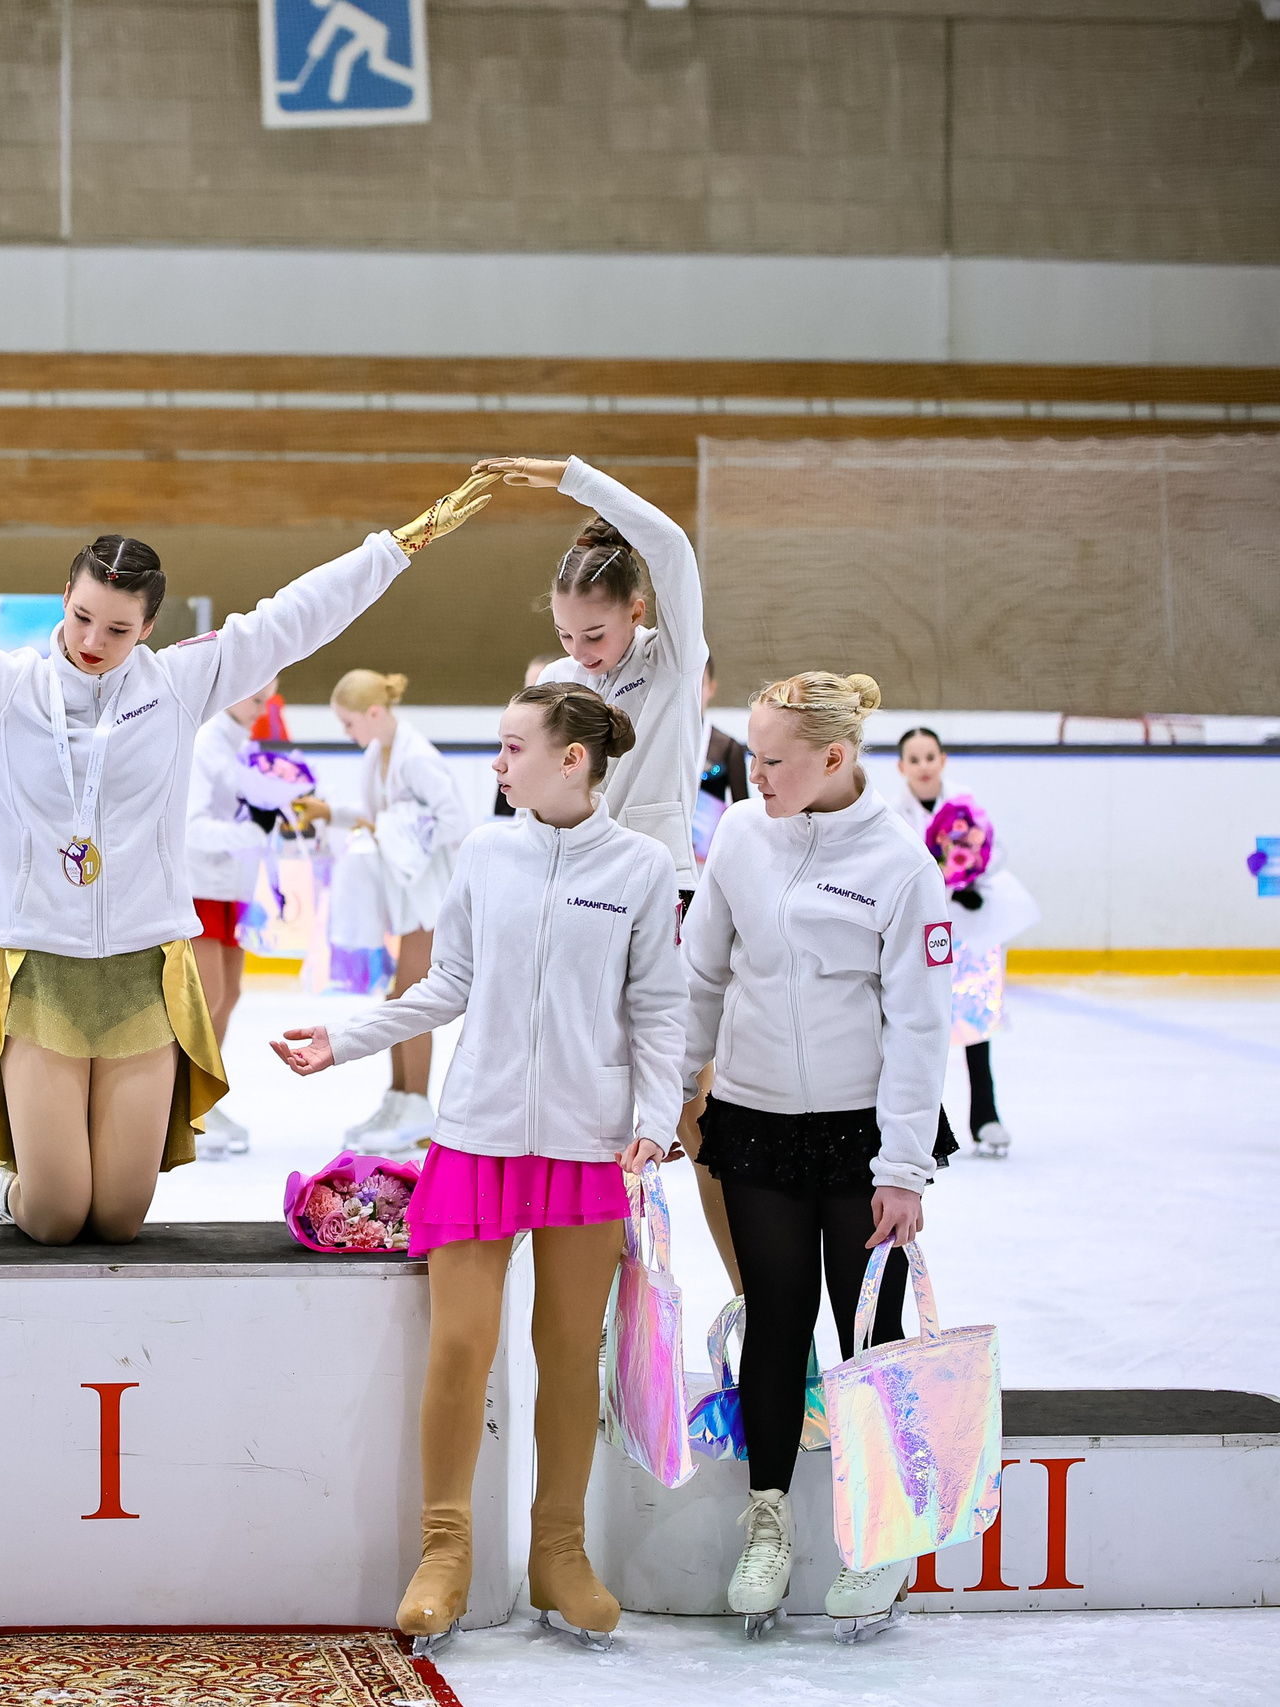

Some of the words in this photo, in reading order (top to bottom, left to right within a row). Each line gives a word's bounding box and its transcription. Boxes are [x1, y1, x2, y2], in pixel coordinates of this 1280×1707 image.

[614, 676, 646, 698] АНГЕЛЬСК
[567, 898, 572, 906] г.
[574, 896, 628, 914] АРХАНГЕЛЬСК
[823, 884, 877, 907] АРХАНГЕЛЬСК
[928, 938, 948, 948] CANDY
[81, 1382, 140, 1520] I
[907, 1458, 1086, 1593] II
